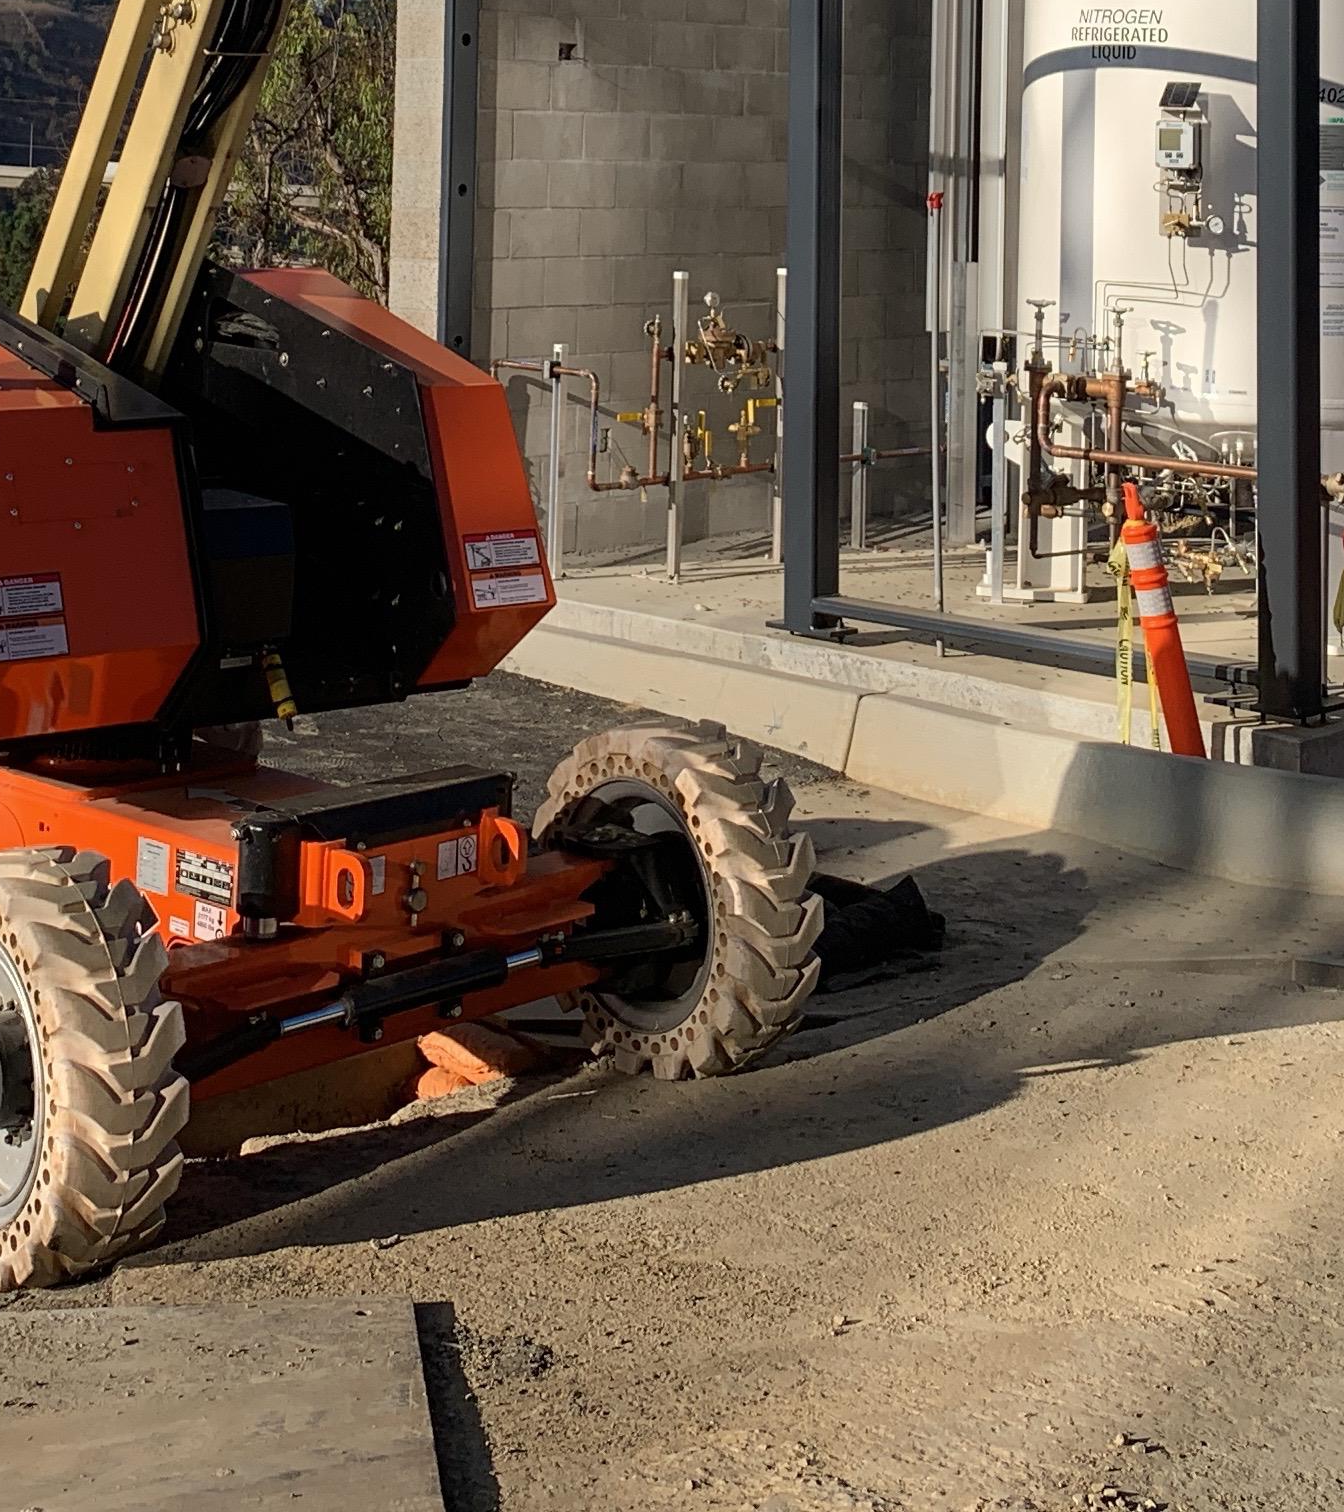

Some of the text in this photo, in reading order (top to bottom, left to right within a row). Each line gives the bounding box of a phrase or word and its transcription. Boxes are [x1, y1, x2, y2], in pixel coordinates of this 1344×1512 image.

[1078, 8, 1163, 25] NITROGEN
[1071, 26, 1169, 43] REFRIGERATED
[1091, 44, 1137, 62] LIQUID
